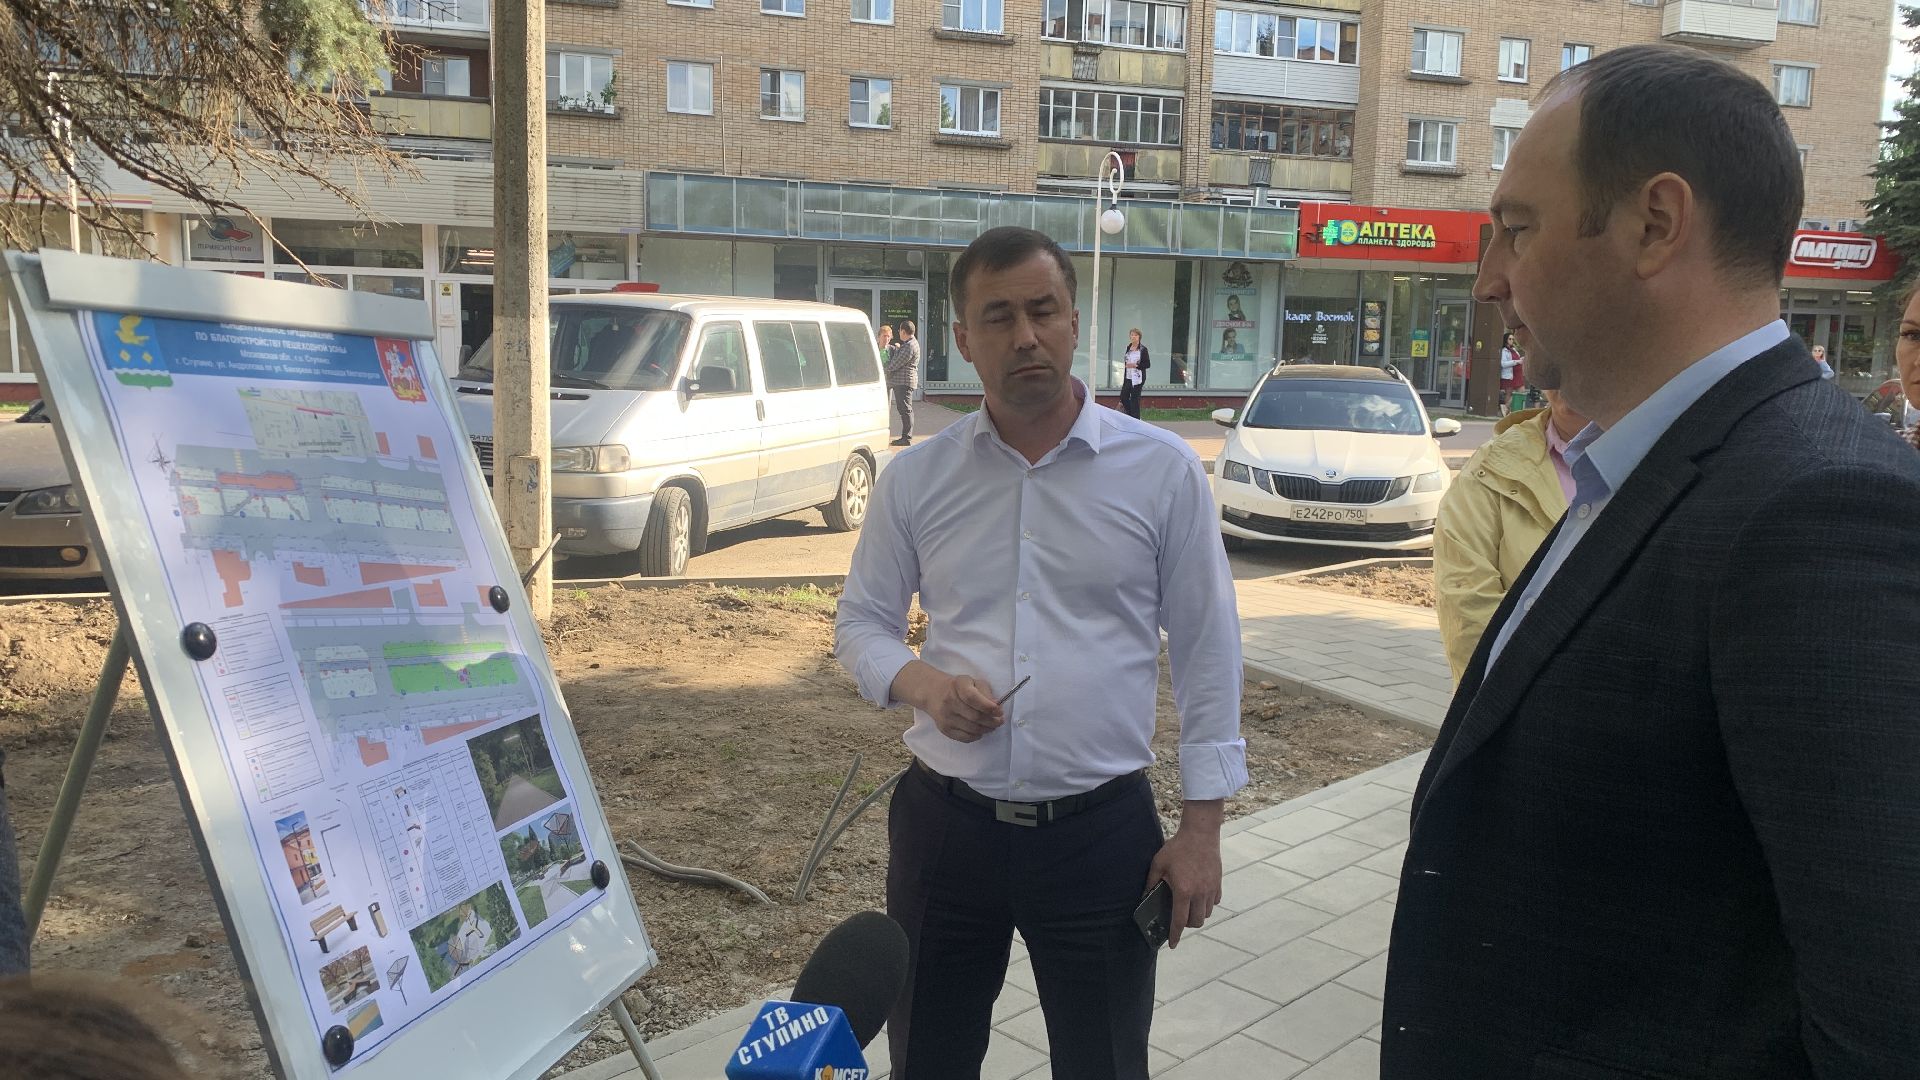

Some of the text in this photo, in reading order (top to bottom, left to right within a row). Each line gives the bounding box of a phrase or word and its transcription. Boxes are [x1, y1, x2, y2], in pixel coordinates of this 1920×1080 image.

[1360, 221, 1436, 240] АПТЕКА
[1358, 238, 1436, 248] ПЛАНЕТА ЗДОРОВЬЯ
[1795, 241, 1871, 260] МАГНИТ
[1285, 310, 1354, 323] кафе Восток
[195, 332, 208, 341] ПО
[210, 333, 281, 348] БЛАГОУСТРОЙСТВУ
[1414, 343, 1426, 352] 24
[469, 434, 494, 442] RATIO
[762, 1006, 790, 1030] ТВ
[737, 1006, 830, 1065] СТУПИНО
